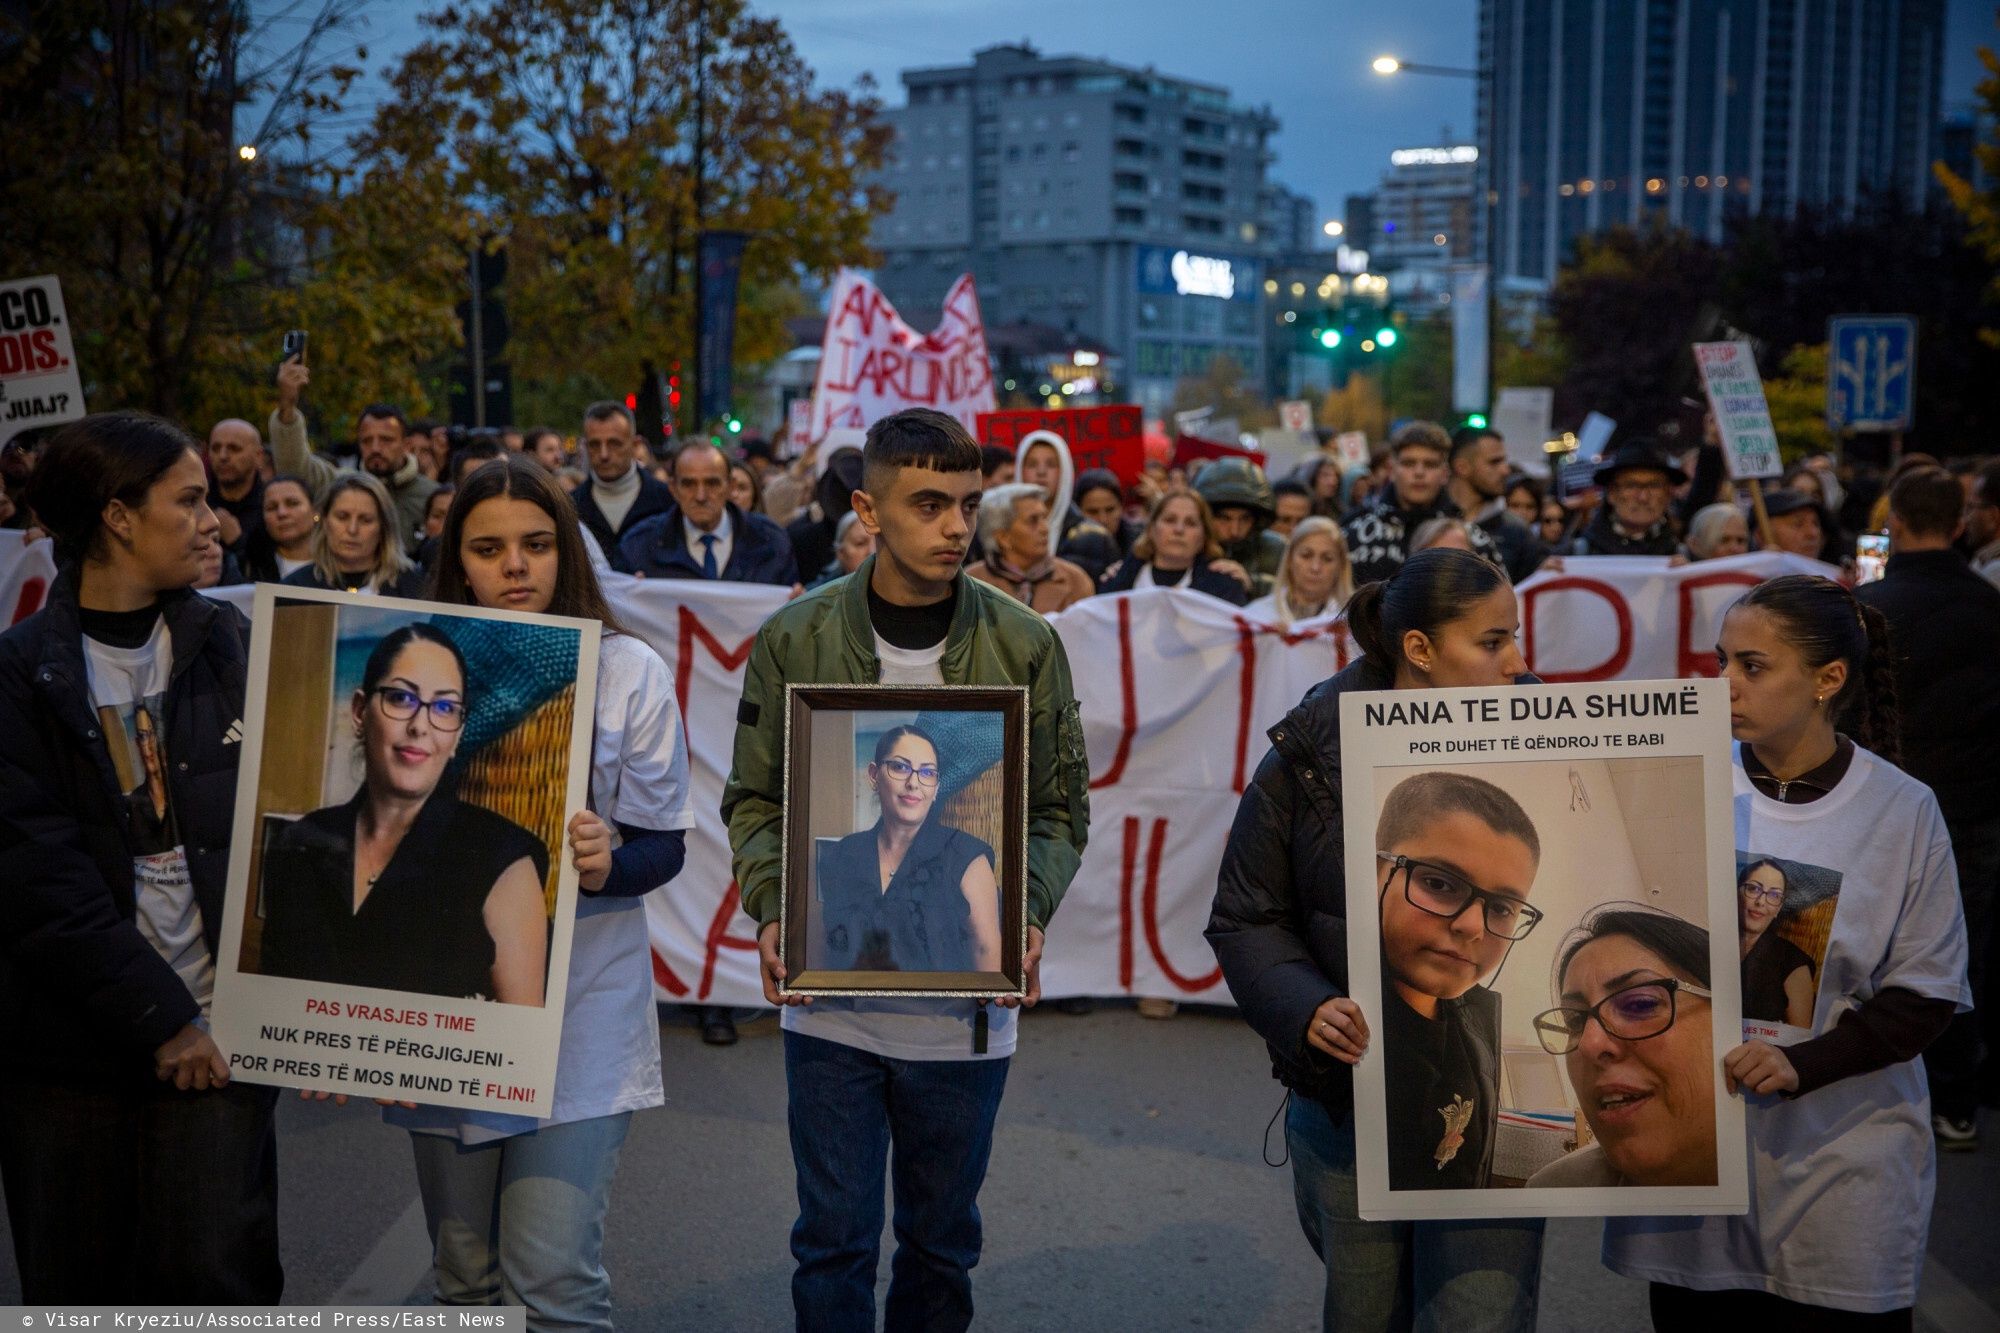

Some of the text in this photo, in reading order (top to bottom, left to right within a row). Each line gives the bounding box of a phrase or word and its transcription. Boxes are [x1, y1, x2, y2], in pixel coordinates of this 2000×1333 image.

[6, 394, 68, 420] JUAJ?
[1364, 686, 1700, 727] NANA TE DUA SHUMË
[1409, 733, 1665, 754] POR DUHET TË QËNDROJ TE BABI
[306, 998, 477, 1033] PAS VRASJES TIME
[1760, 1027, 1779, 1037] TIME
[260, 1025, 299, 1044] NUK
[303, 1030, 352, 1050] PRES
[357, 1033, 380, 1052] TË
[384, 1037, 504, 1067] PËRGJIGJENI
[229, 1053, 536, 1103] POR PRES TË MOS MUND TË FLINI!
